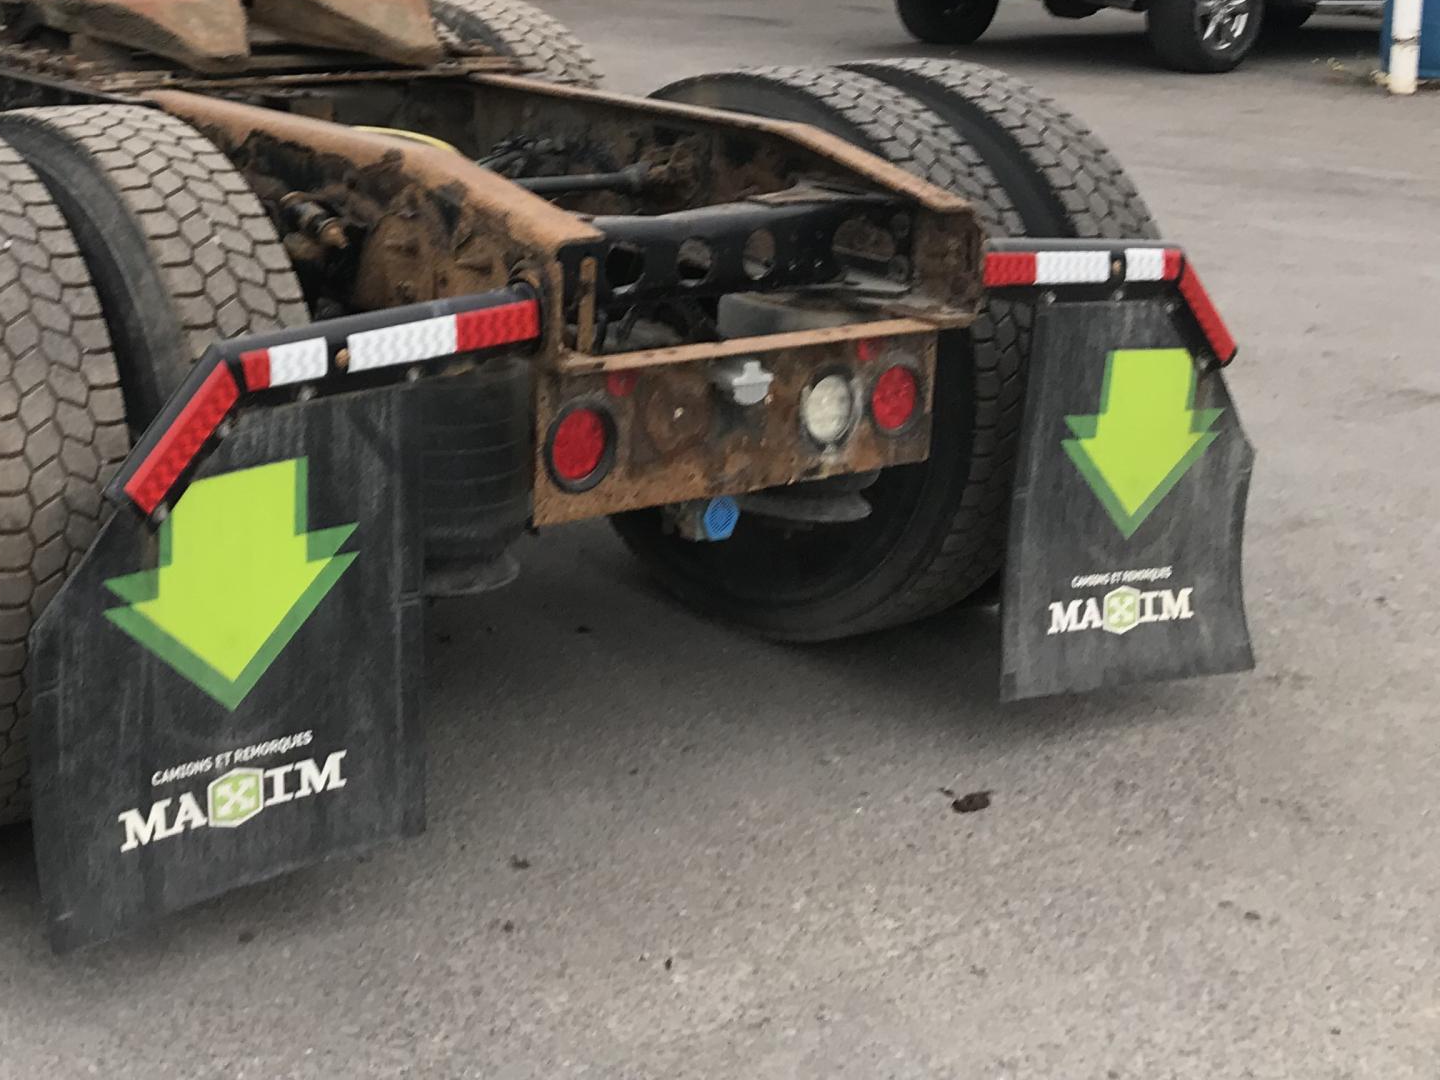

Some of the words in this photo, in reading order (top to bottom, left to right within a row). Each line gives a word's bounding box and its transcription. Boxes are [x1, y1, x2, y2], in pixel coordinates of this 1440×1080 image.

[1047, 585, 1195, 635] MAXIM
[151, 756, 213, 786] CAMIONS
[214, 751, 234, 769] ET
[233, 730, 313, 764] REMORQUES
[117, 749, 348, 853] MAXIM
